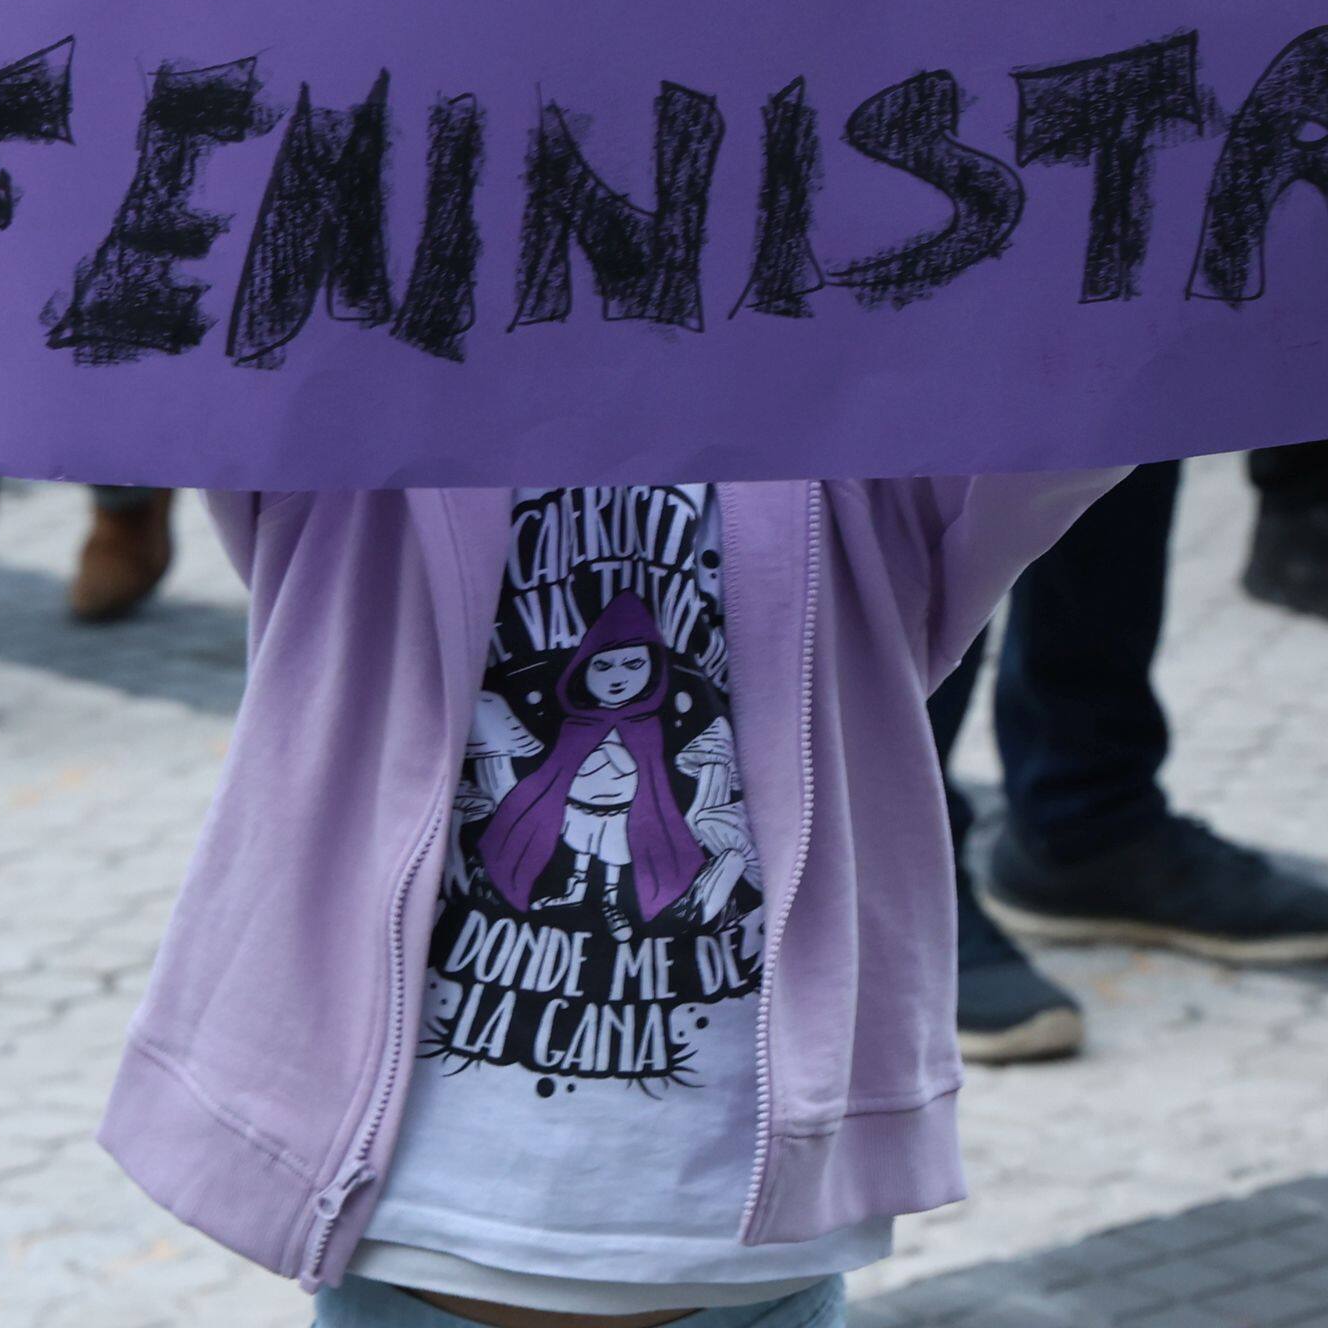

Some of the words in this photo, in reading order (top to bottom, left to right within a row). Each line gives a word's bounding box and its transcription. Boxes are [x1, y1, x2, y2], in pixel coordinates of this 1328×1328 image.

[444, 909, 593, 997] DONDE
[609, 936, 677, 1001] ME
[451, 983, 516, 1059] LA
[533, 998, 669, 1072] GANA
